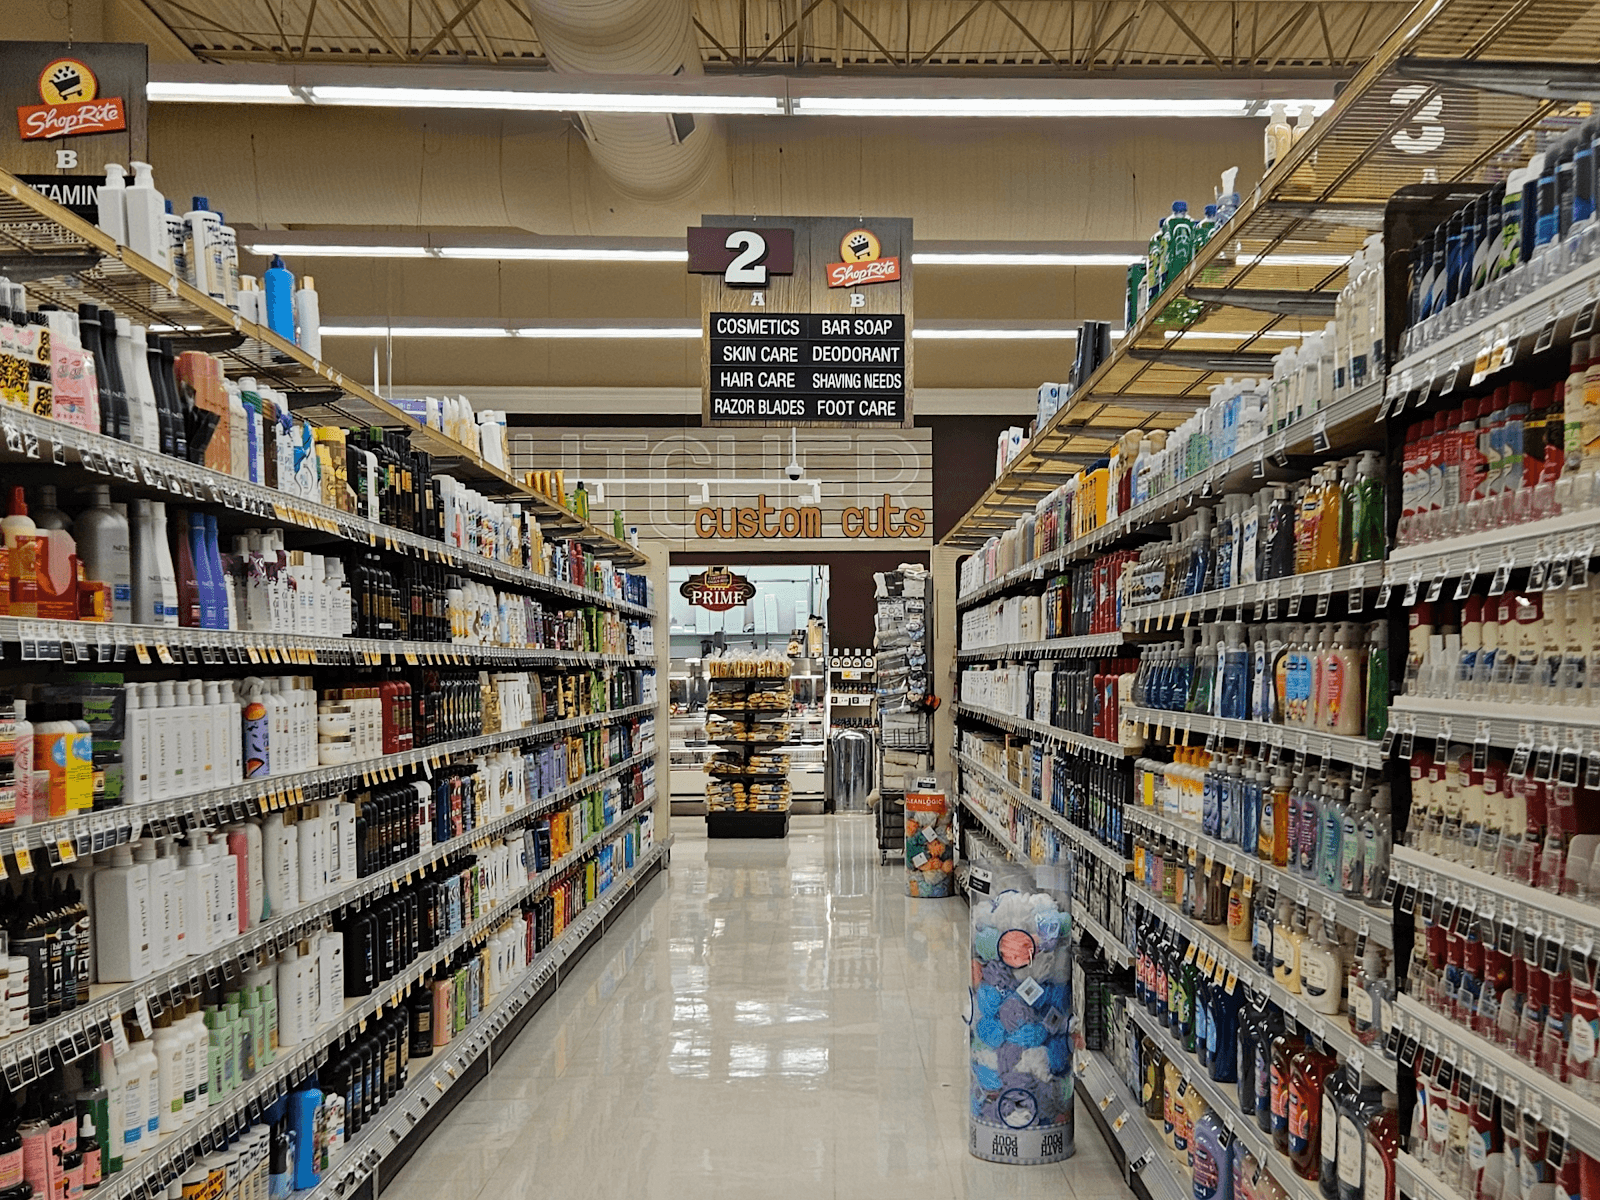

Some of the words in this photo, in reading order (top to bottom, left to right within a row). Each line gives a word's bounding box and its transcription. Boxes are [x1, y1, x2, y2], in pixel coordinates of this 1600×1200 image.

[26, 102, 118, 138] ShopRite
[1390, 84, 1446, 154] 3
[56, 150, 78, 169] B
[725, 230, 766, 284] 2
[831, 261, 896, 287] ShopRite
[750, 292, 766, 306] A
[850, 294, 865, 307] B
[716, 318, 800, 335] COSMETICS
[821, 319, 850, 335] BAR
[854, 319, 893, 335] SOAP
[723, 346, 756, 362] SKIN
[760, 346, 798, 363] CARE
[812, 346, 900, 363] DEODORANT
[720, 372, 754, 388] HAIR
[757, 372, 796, 388] CARE
[812, 373, 861, 389] SHAVING
[863, 373, 902, 389] NEEDS
[714, 398, 755, 415] RAZOR
[758, 399, 805, 415] BLADES
[817, 400, 855, 416] FOOT
[858, 401, 896, 416] CARE
[695, 493, 822, 538] custom
[841, 493, 926, 538] cuts
[691, 590, 745, 605] PRIME
[992, 1134, 1018, 1147] POUF
[1042, 1133, 1063, 1146] POUF
[992, 1144, 1018, 1157] BATH
[1041, 1142, 1063, 1157] BATH
